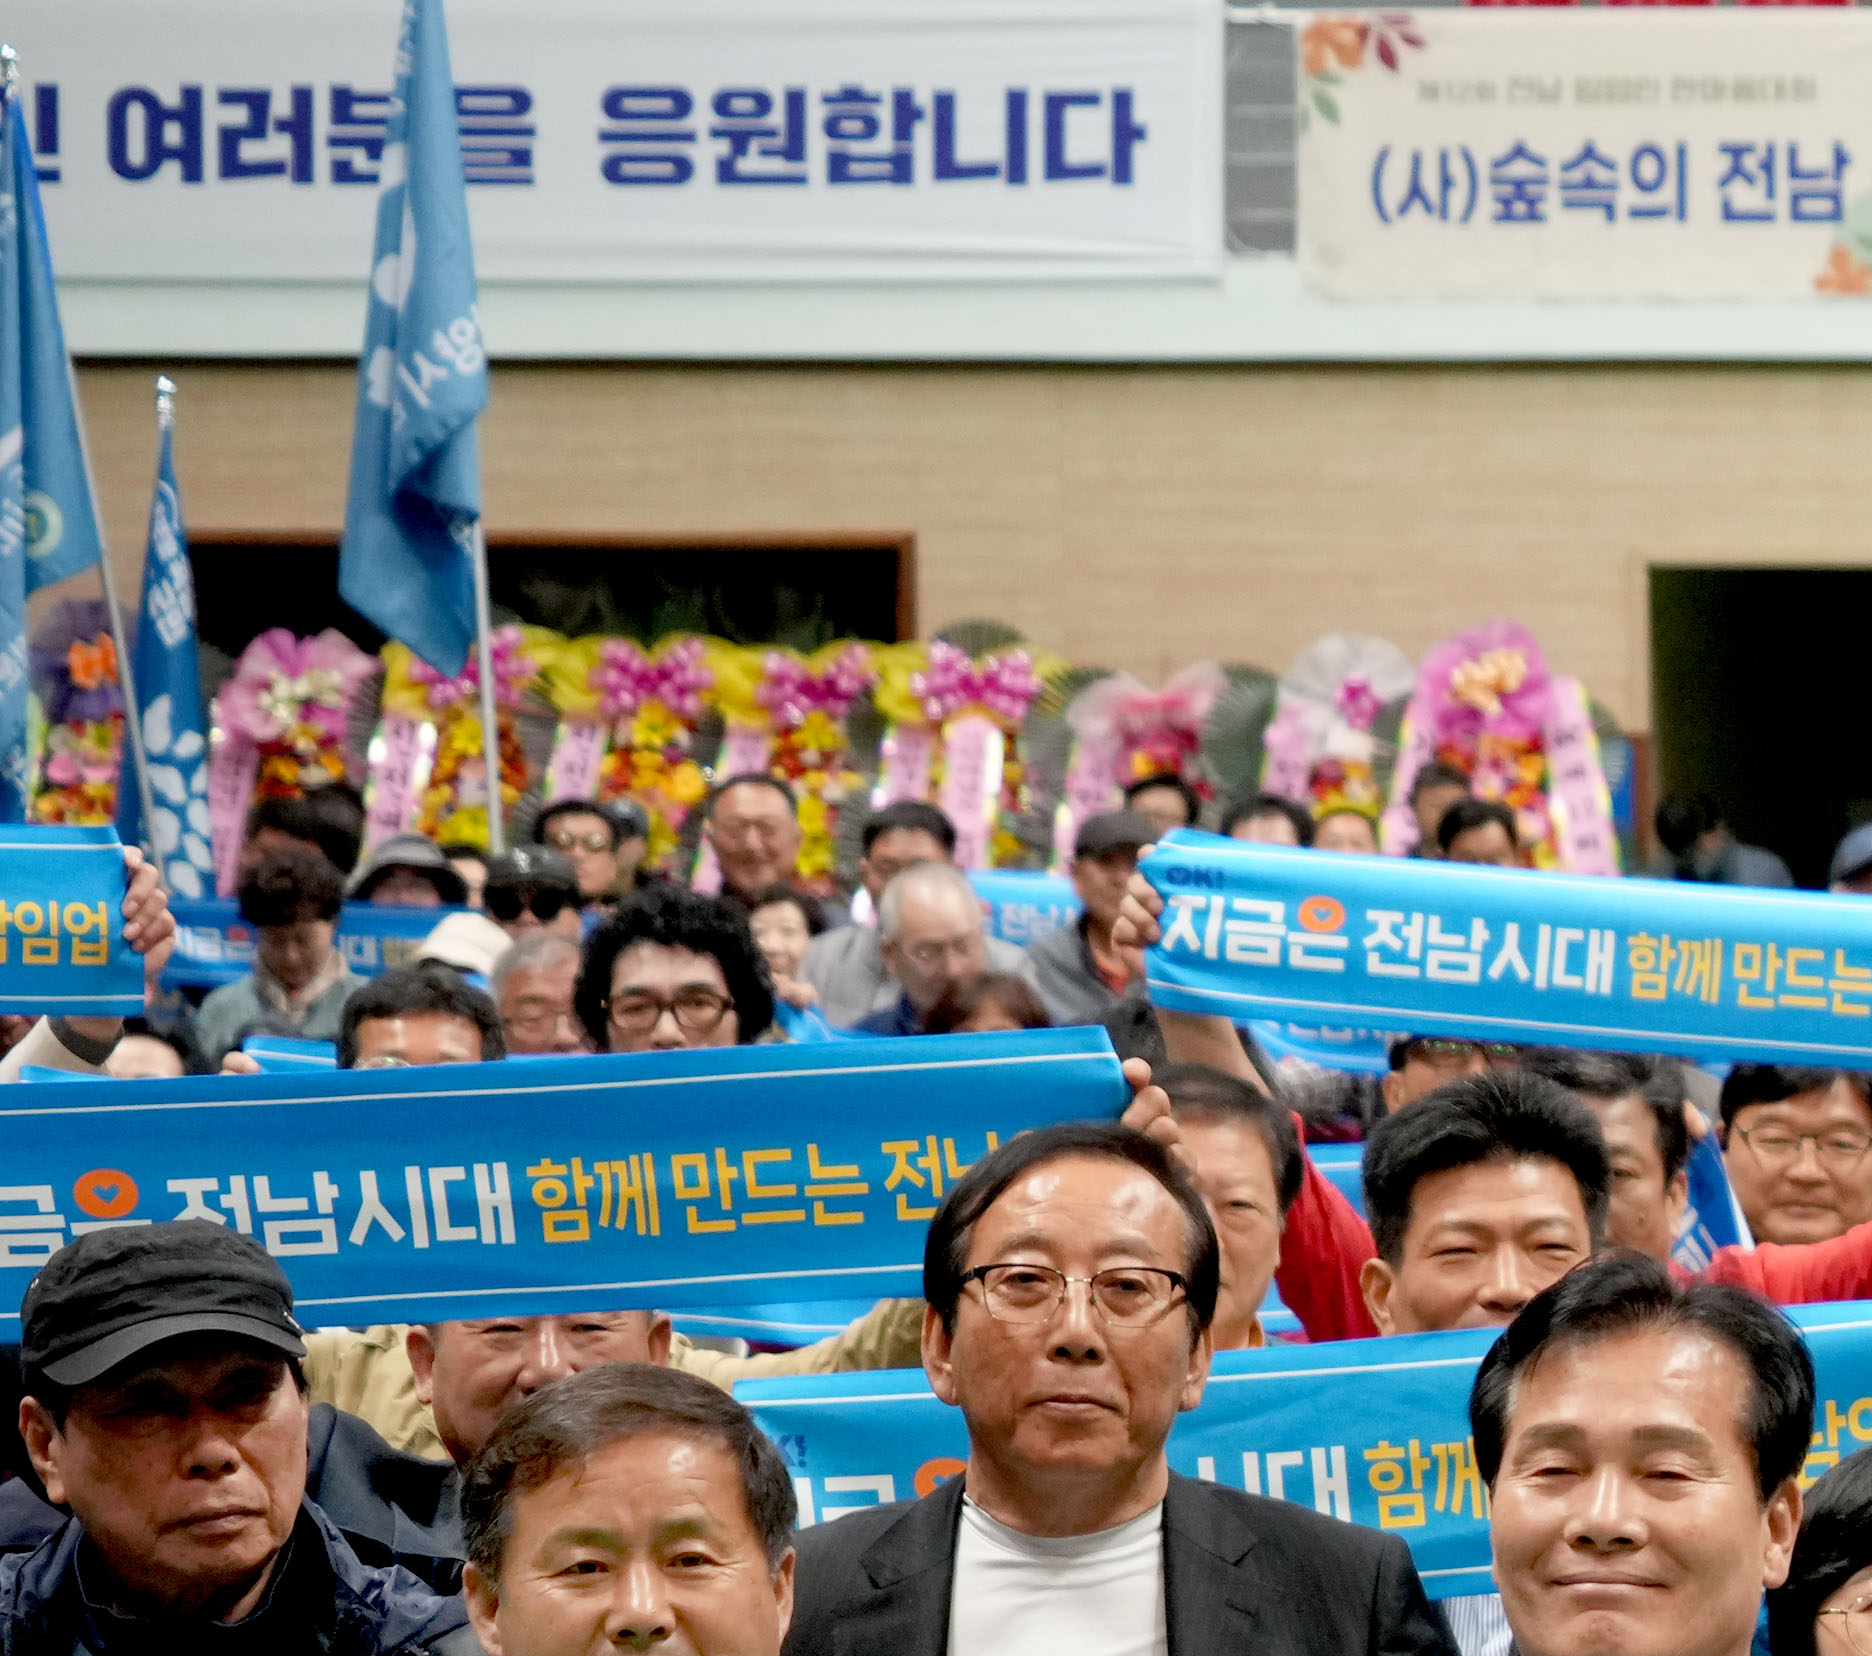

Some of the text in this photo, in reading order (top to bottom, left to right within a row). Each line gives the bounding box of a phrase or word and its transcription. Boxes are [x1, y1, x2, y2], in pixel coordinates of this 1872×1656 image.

[107, 85, 536, 187] 여러분을
[599, 85, 1148, 187] 응원합니다
[1371, 140, 1851, 224] (사)숲속의 전남
[1160, 894, 1349, 973] 지금은
[1362, 908, 1616, 995] 전남시대
[1626, 931, 1723, 1005] 함께
[165, 1160, 518, 1257] 전남시대
[525, 1152, 661, 1244] 함께
[670, 1142, 870, 1236] 만드는
